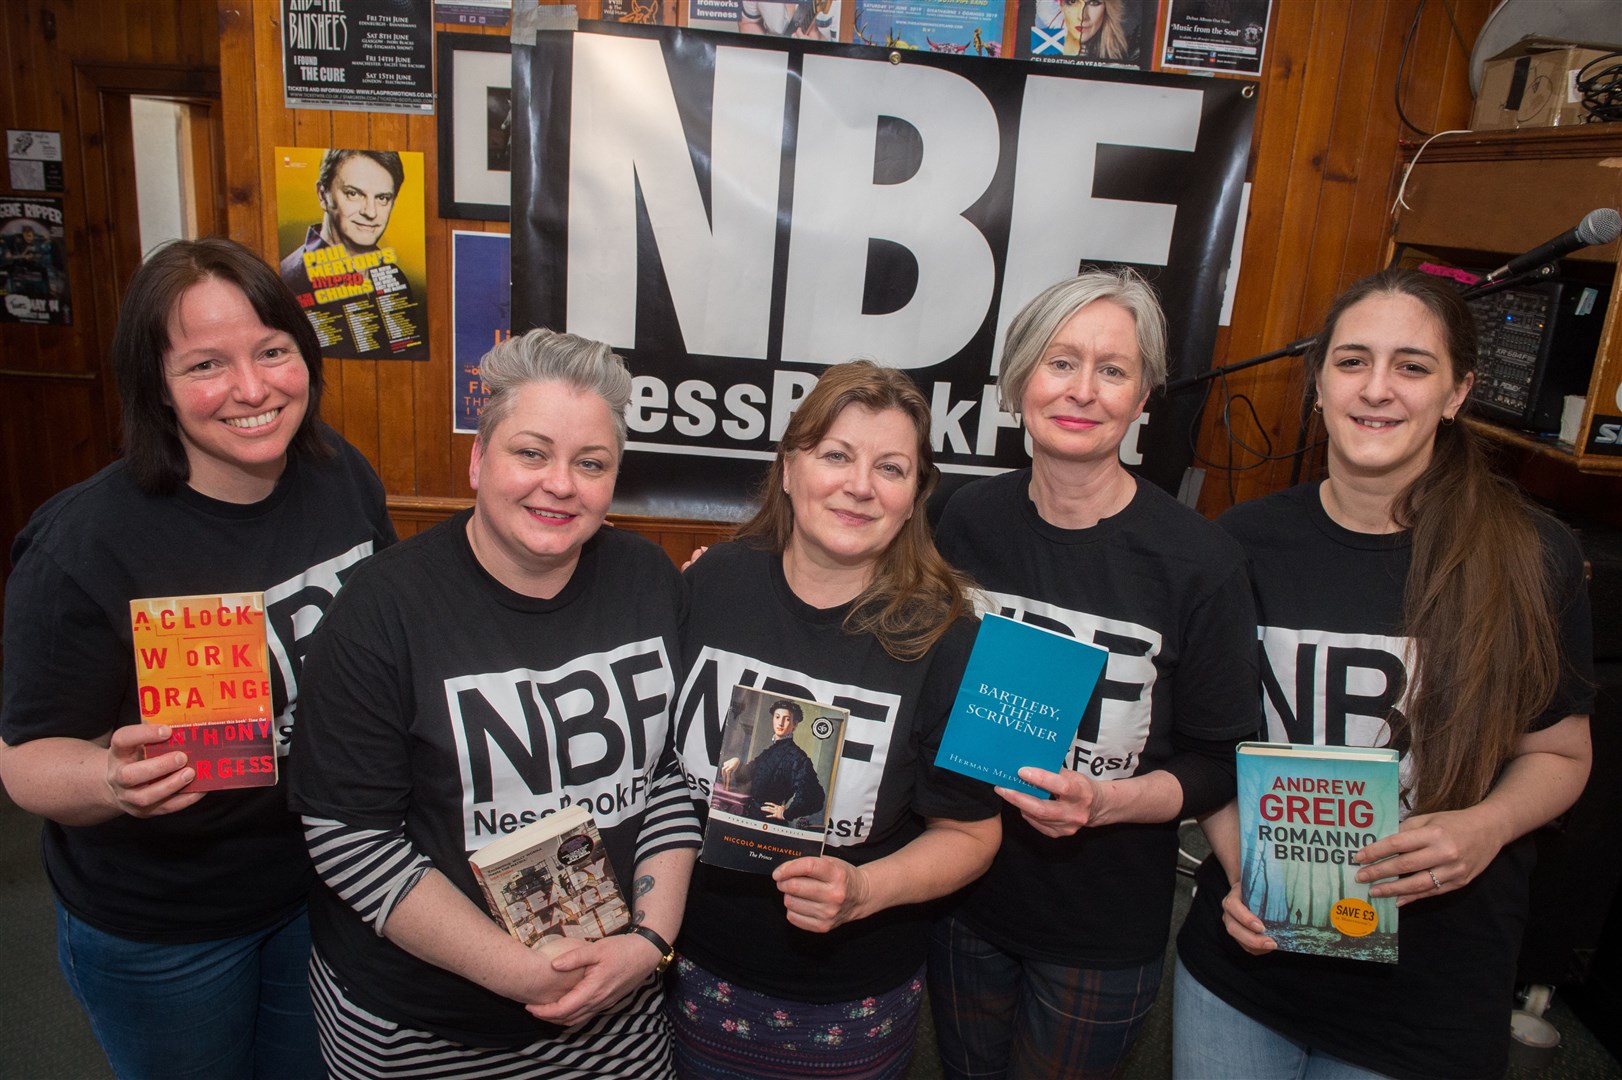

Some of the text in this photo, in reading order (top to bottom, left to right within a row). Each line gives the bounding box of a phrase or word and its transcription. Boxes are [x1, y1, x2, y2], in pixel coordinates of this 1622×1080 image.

[696, 9, 738, 19] Inverness
[697, 0, 739, 8] Ironworks
[289, 12, 347, 51] BANSHEES
[1193, 24, 1211, 34] from
[1211, 26, 1223, 35] the
[300, 66, 345, 82] THE CURE
[24, 203, 63, 225] RIPPER
[303, 244, 348, 268] PAUL
[314, 279, 374, 304] CHUMS
[134, 611, 151, 632] A
[140, 643, 253, 670] WORK
[140, 680, 270, 717] ORANGE
[978, 682, 1061, 722] BARTLEBY,
[966, 703, 1058, 743] SCRIVENER
[1000, 701, 1034, 723] THE
[152, 720, 270, 747] NTHONY
[457, 649, 669, 805] NBF
[949, 753, 990, 773] HERMAN
[1272, 776, 1366, 797] ANDREW
[1259, 794, 1375, 828] GREIG
[1258, 825, 1377, 849] ROMANNO
[749, 850, 773, 861] The Prince
[756, 843, 802, 857] MACHIAVELLI
[1274, 844, 1362, 867] BRIDGE
[1336, 904, 1361, 919] SAVE
[1362, 910, 1375, 922] £3
